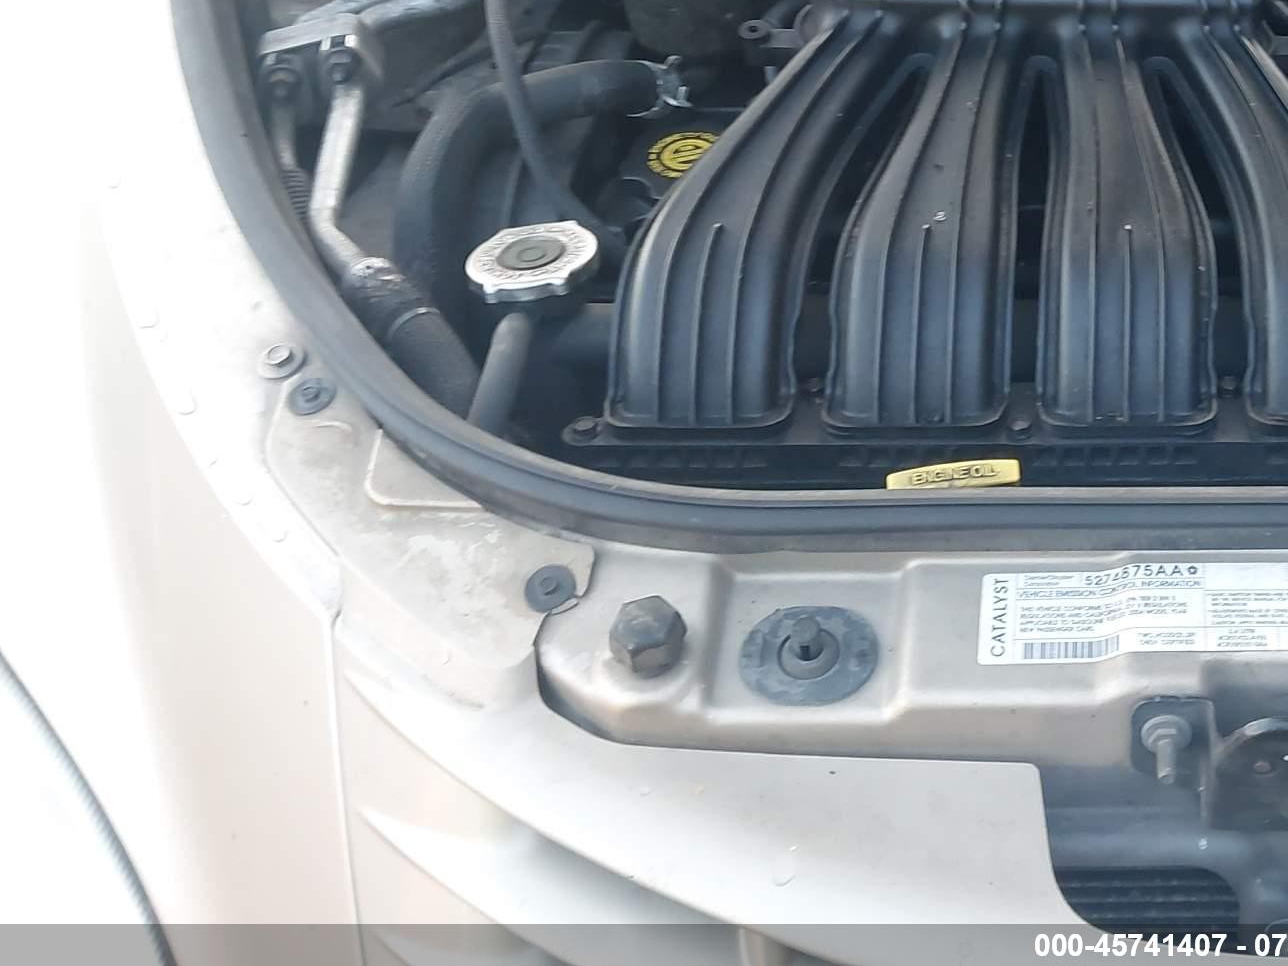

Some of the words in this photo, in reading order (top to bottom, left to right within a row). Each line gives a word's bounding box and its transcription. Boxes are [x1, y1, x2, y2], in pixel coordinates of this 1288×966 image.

[911, 466, 969, 485] ENGINE
[969, 463, 998, 478] OIL
[990, 578, 1010, 657] CATALYST
